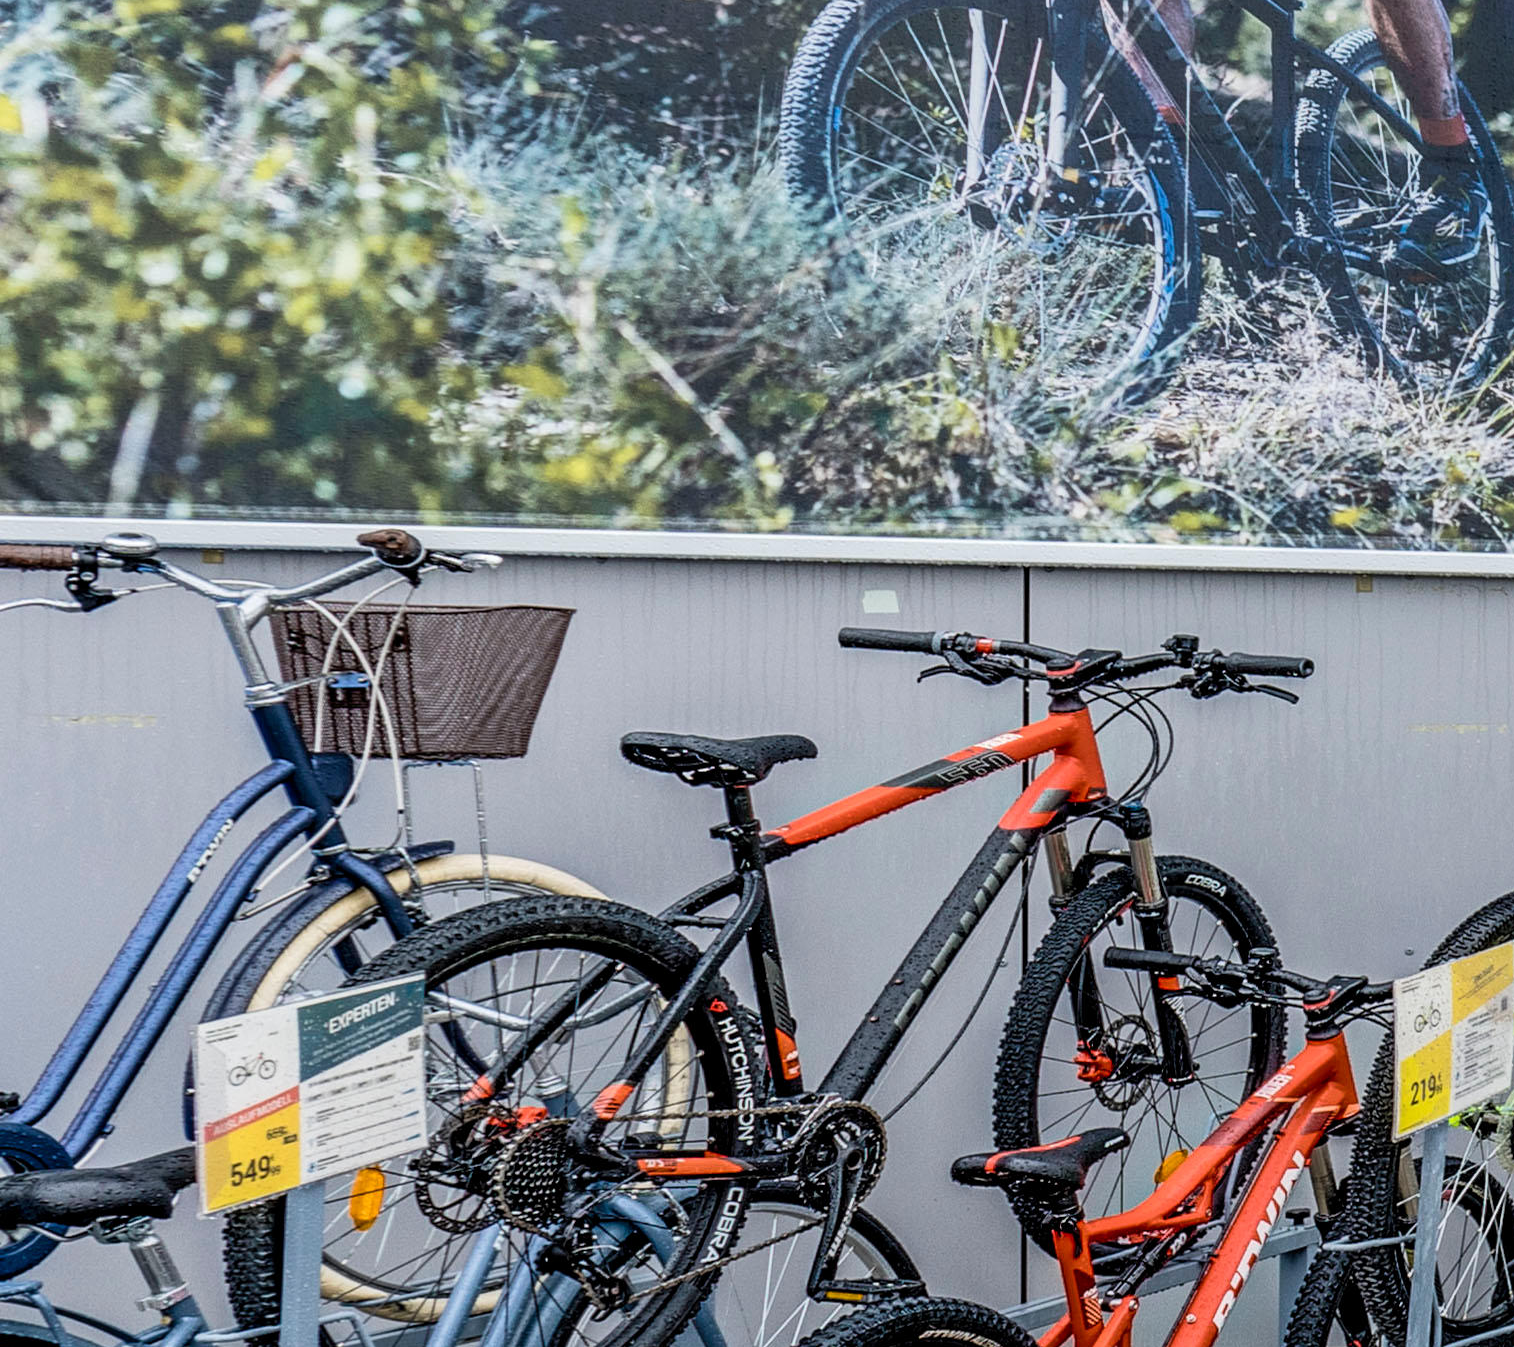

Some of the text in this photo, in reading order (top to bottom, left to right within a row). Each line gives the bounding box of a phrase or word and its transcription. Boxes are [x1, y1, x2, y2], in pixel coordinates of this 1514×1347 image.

[1184, 874, 1227, 897] COBRA
[328, 992, 396, 1034] EXPERTEN
[717, 1016, 754, 1142] HUTCHINSON
[1411, 1075, 1437, 1106] 219
[231, 1156, 271, 1187] 549
[700, 1185, 745, 1264] COBRA
